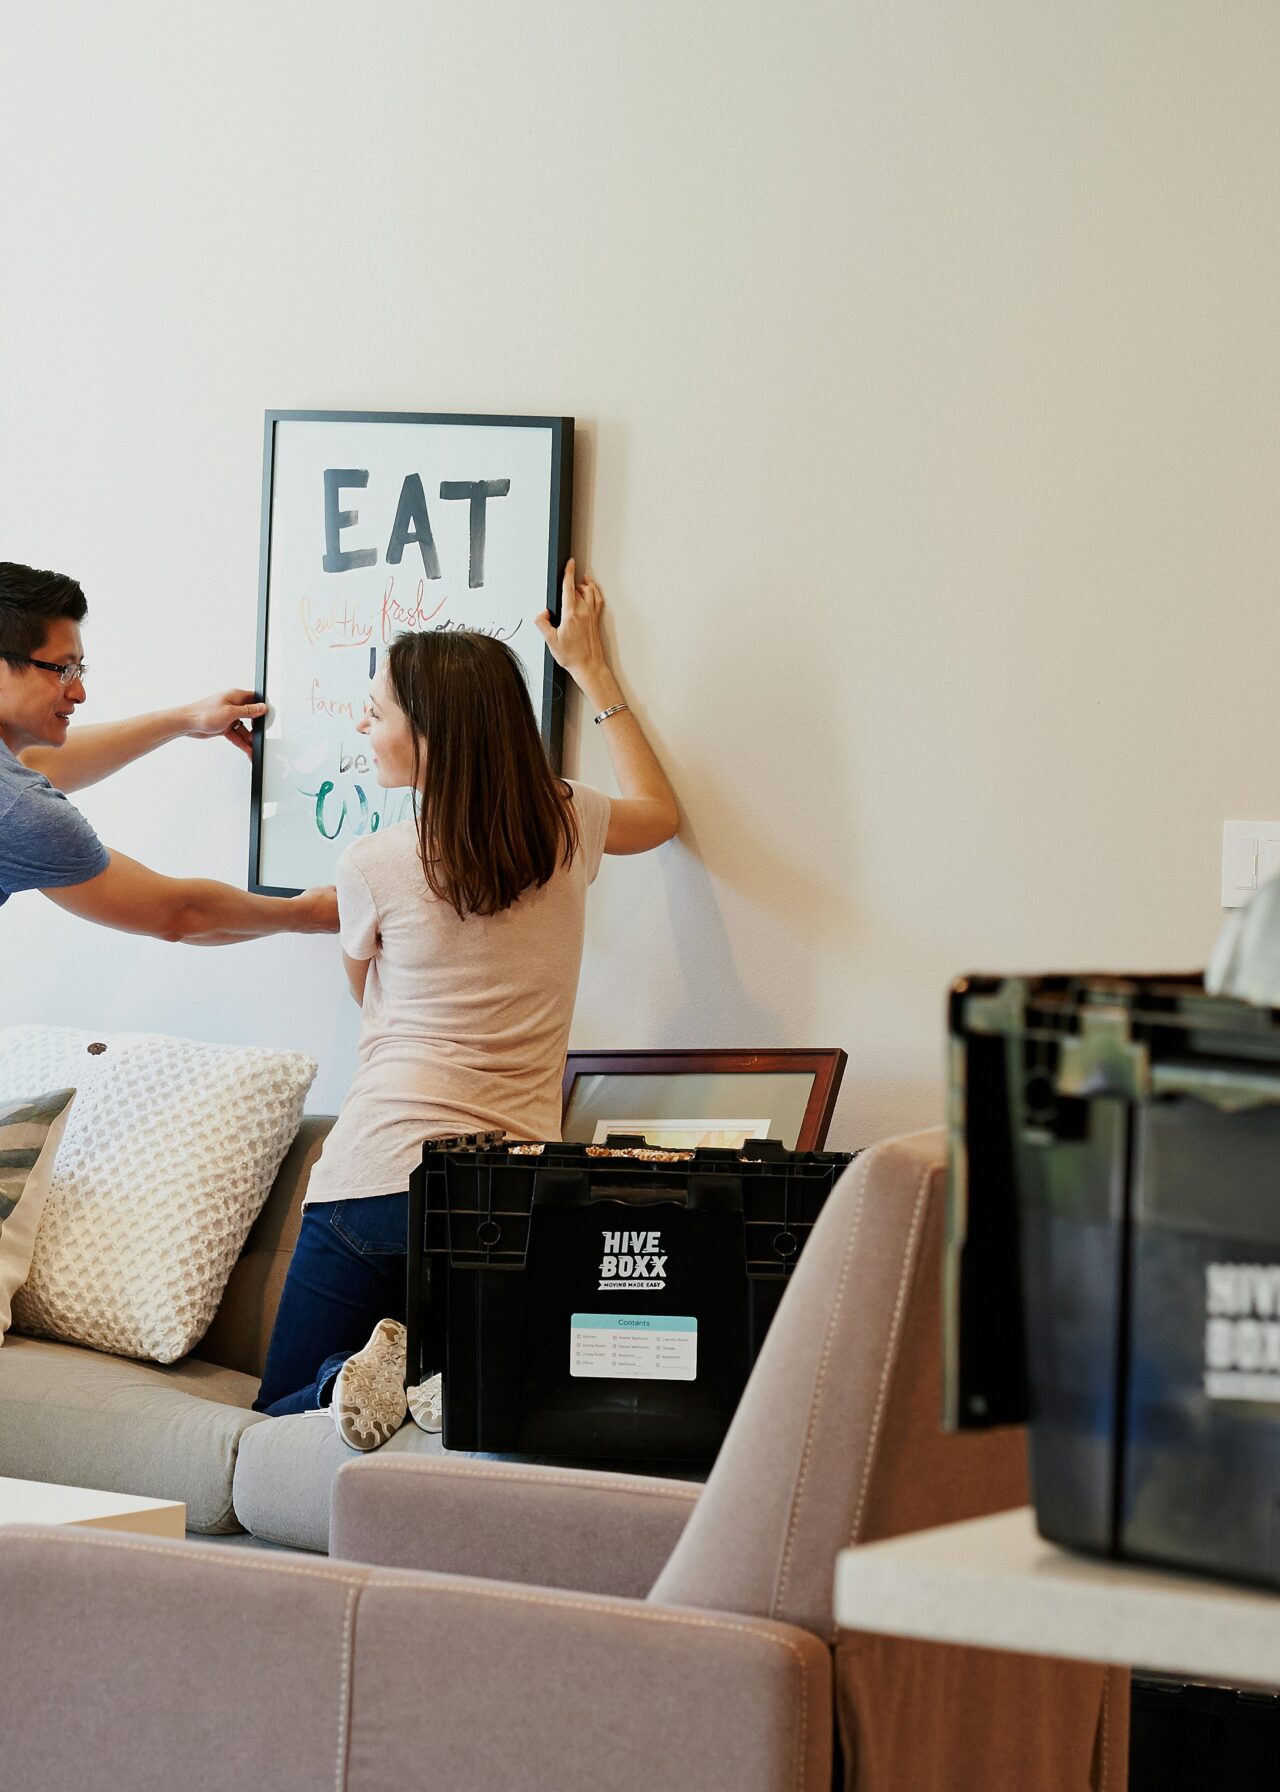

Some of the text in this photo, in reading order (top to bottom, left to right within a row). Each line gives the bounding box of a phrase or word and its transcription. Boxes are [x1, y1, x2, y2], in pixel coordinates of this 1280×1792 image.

[323, 469, 511, 589] EAT
[299, 595, 373, 649] healthy
[381, 576, 447, 644] fresh
[339, 741, 370, 773] be
[601, 1231, 662, 1254] HIVE
[598, 1255, 668, 1277] BOXX
[618, 1319, 650, 1327] Contents
